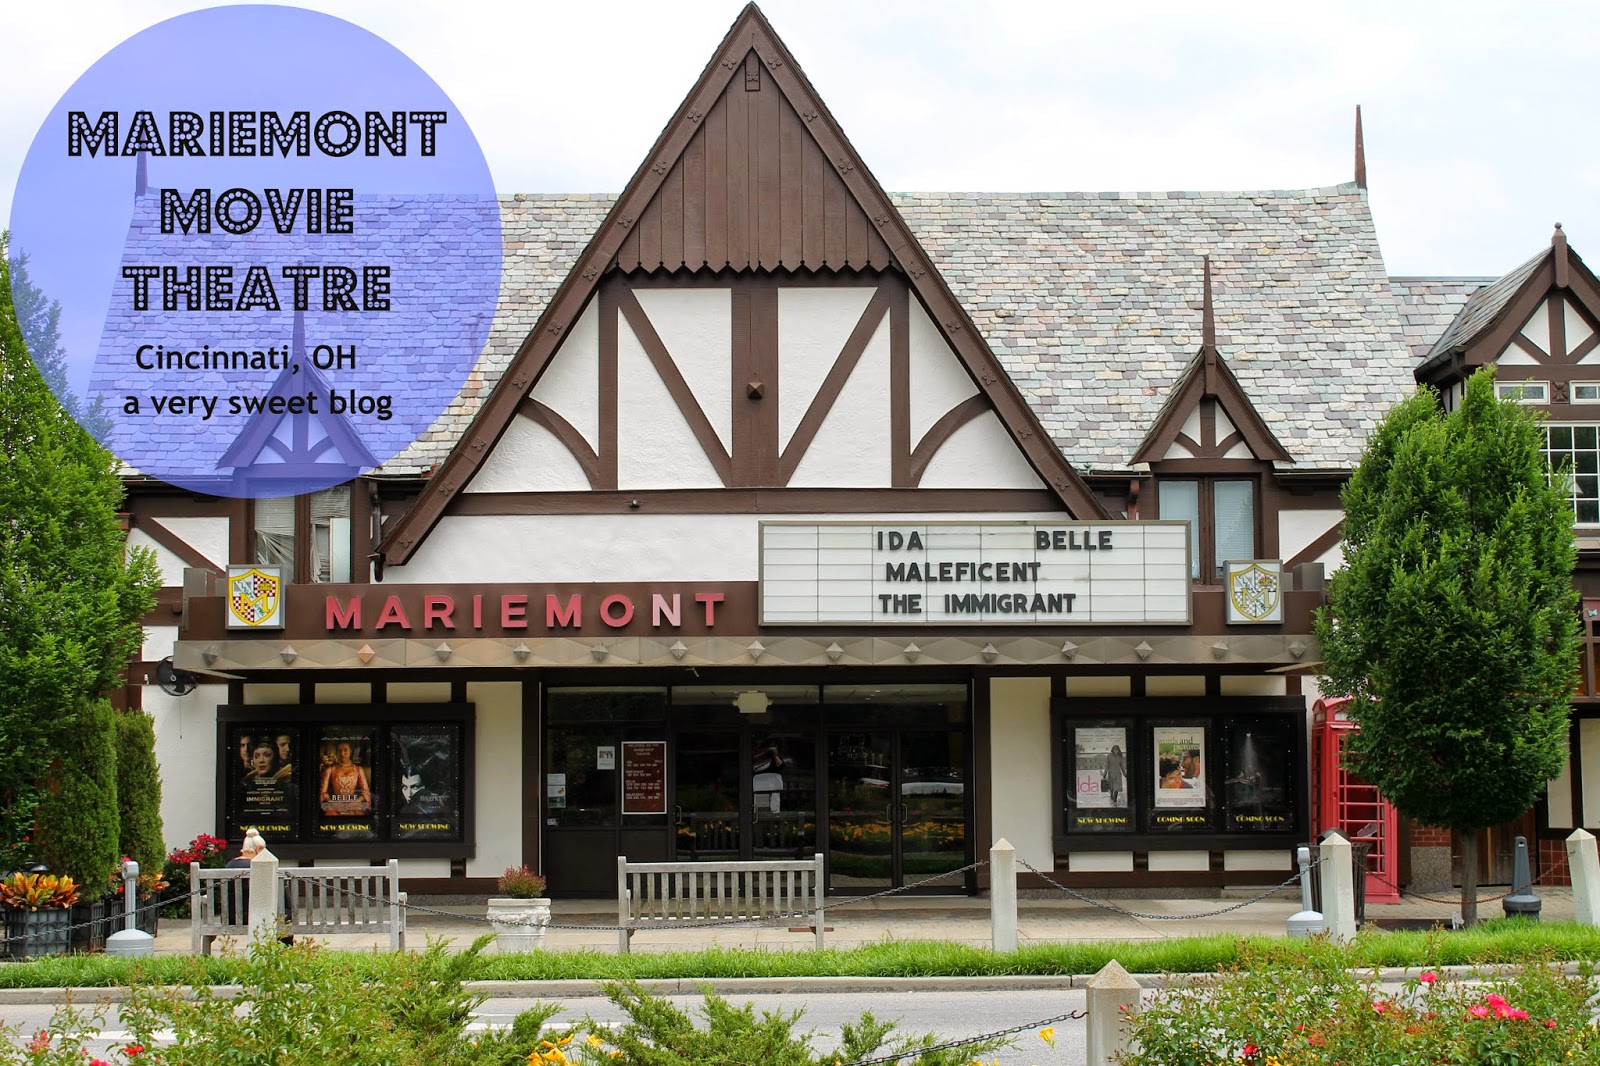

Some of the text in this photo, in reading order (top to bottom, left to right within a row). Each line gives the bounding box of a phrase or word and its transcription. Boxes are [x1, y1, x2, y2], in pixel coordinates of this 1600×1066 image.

[877, 529, 1113, 551] IDA BELLE
[885, 561, 1042, 582] MALEFICENT
[325, 592, 725, 630] MARIEMONT
[878, 592, 1077, 614] THE IMMIGRANT
[1179, 736, 1193, 744] and
[1077, 775, 1100, 793] Ida
[257, 824, 291, 832] SHOWING
